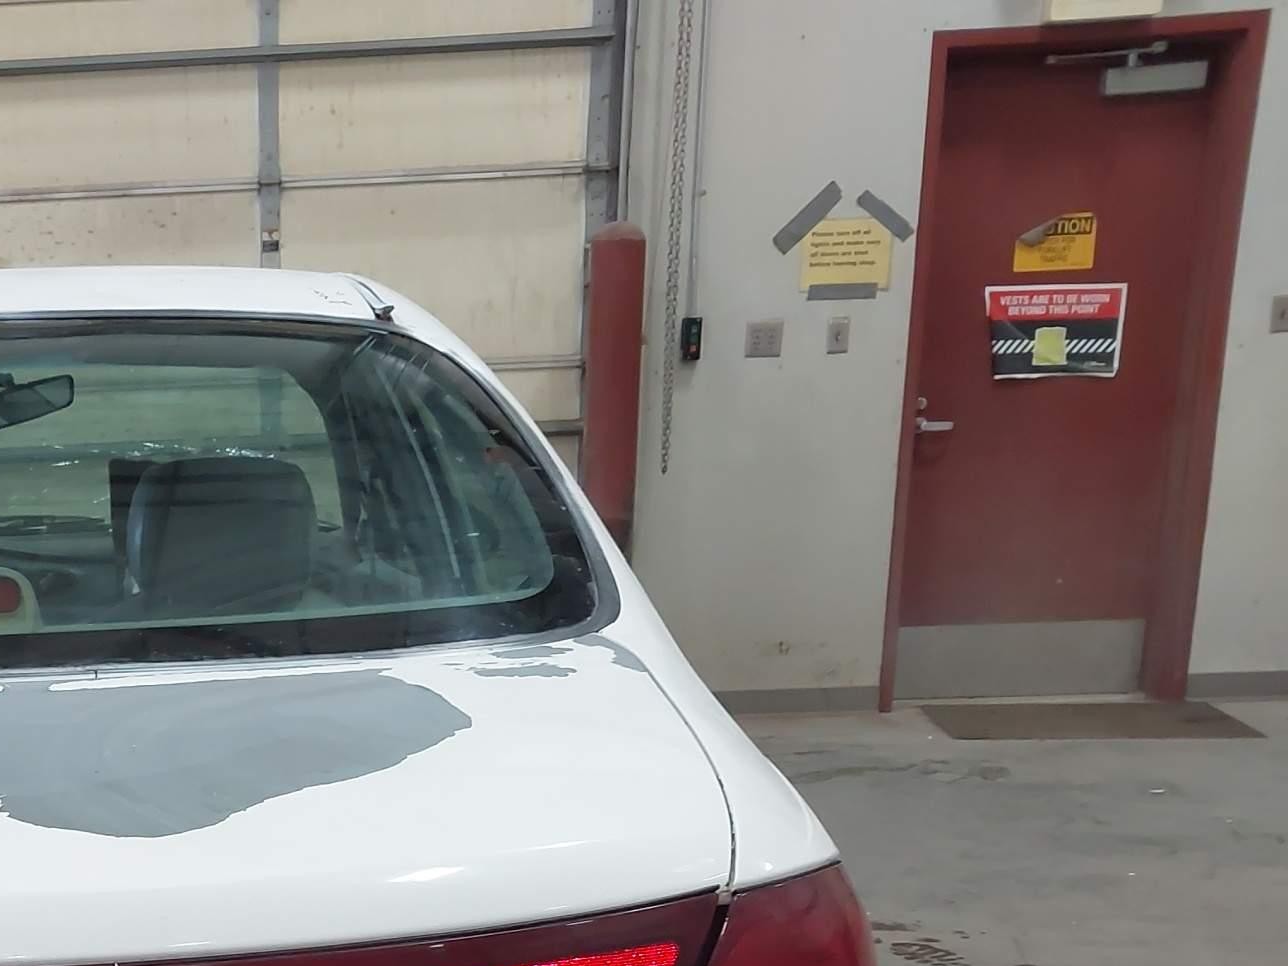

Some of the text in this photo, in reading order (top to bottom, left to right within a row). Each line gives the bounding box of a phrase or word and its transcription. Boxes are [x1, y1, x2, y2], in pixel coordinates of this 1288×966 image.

[1000, 293, 1111, 305] VESTS ARE TO BE WORN
[1007, 303, 1101, 316] BEYOND THIS POINT
